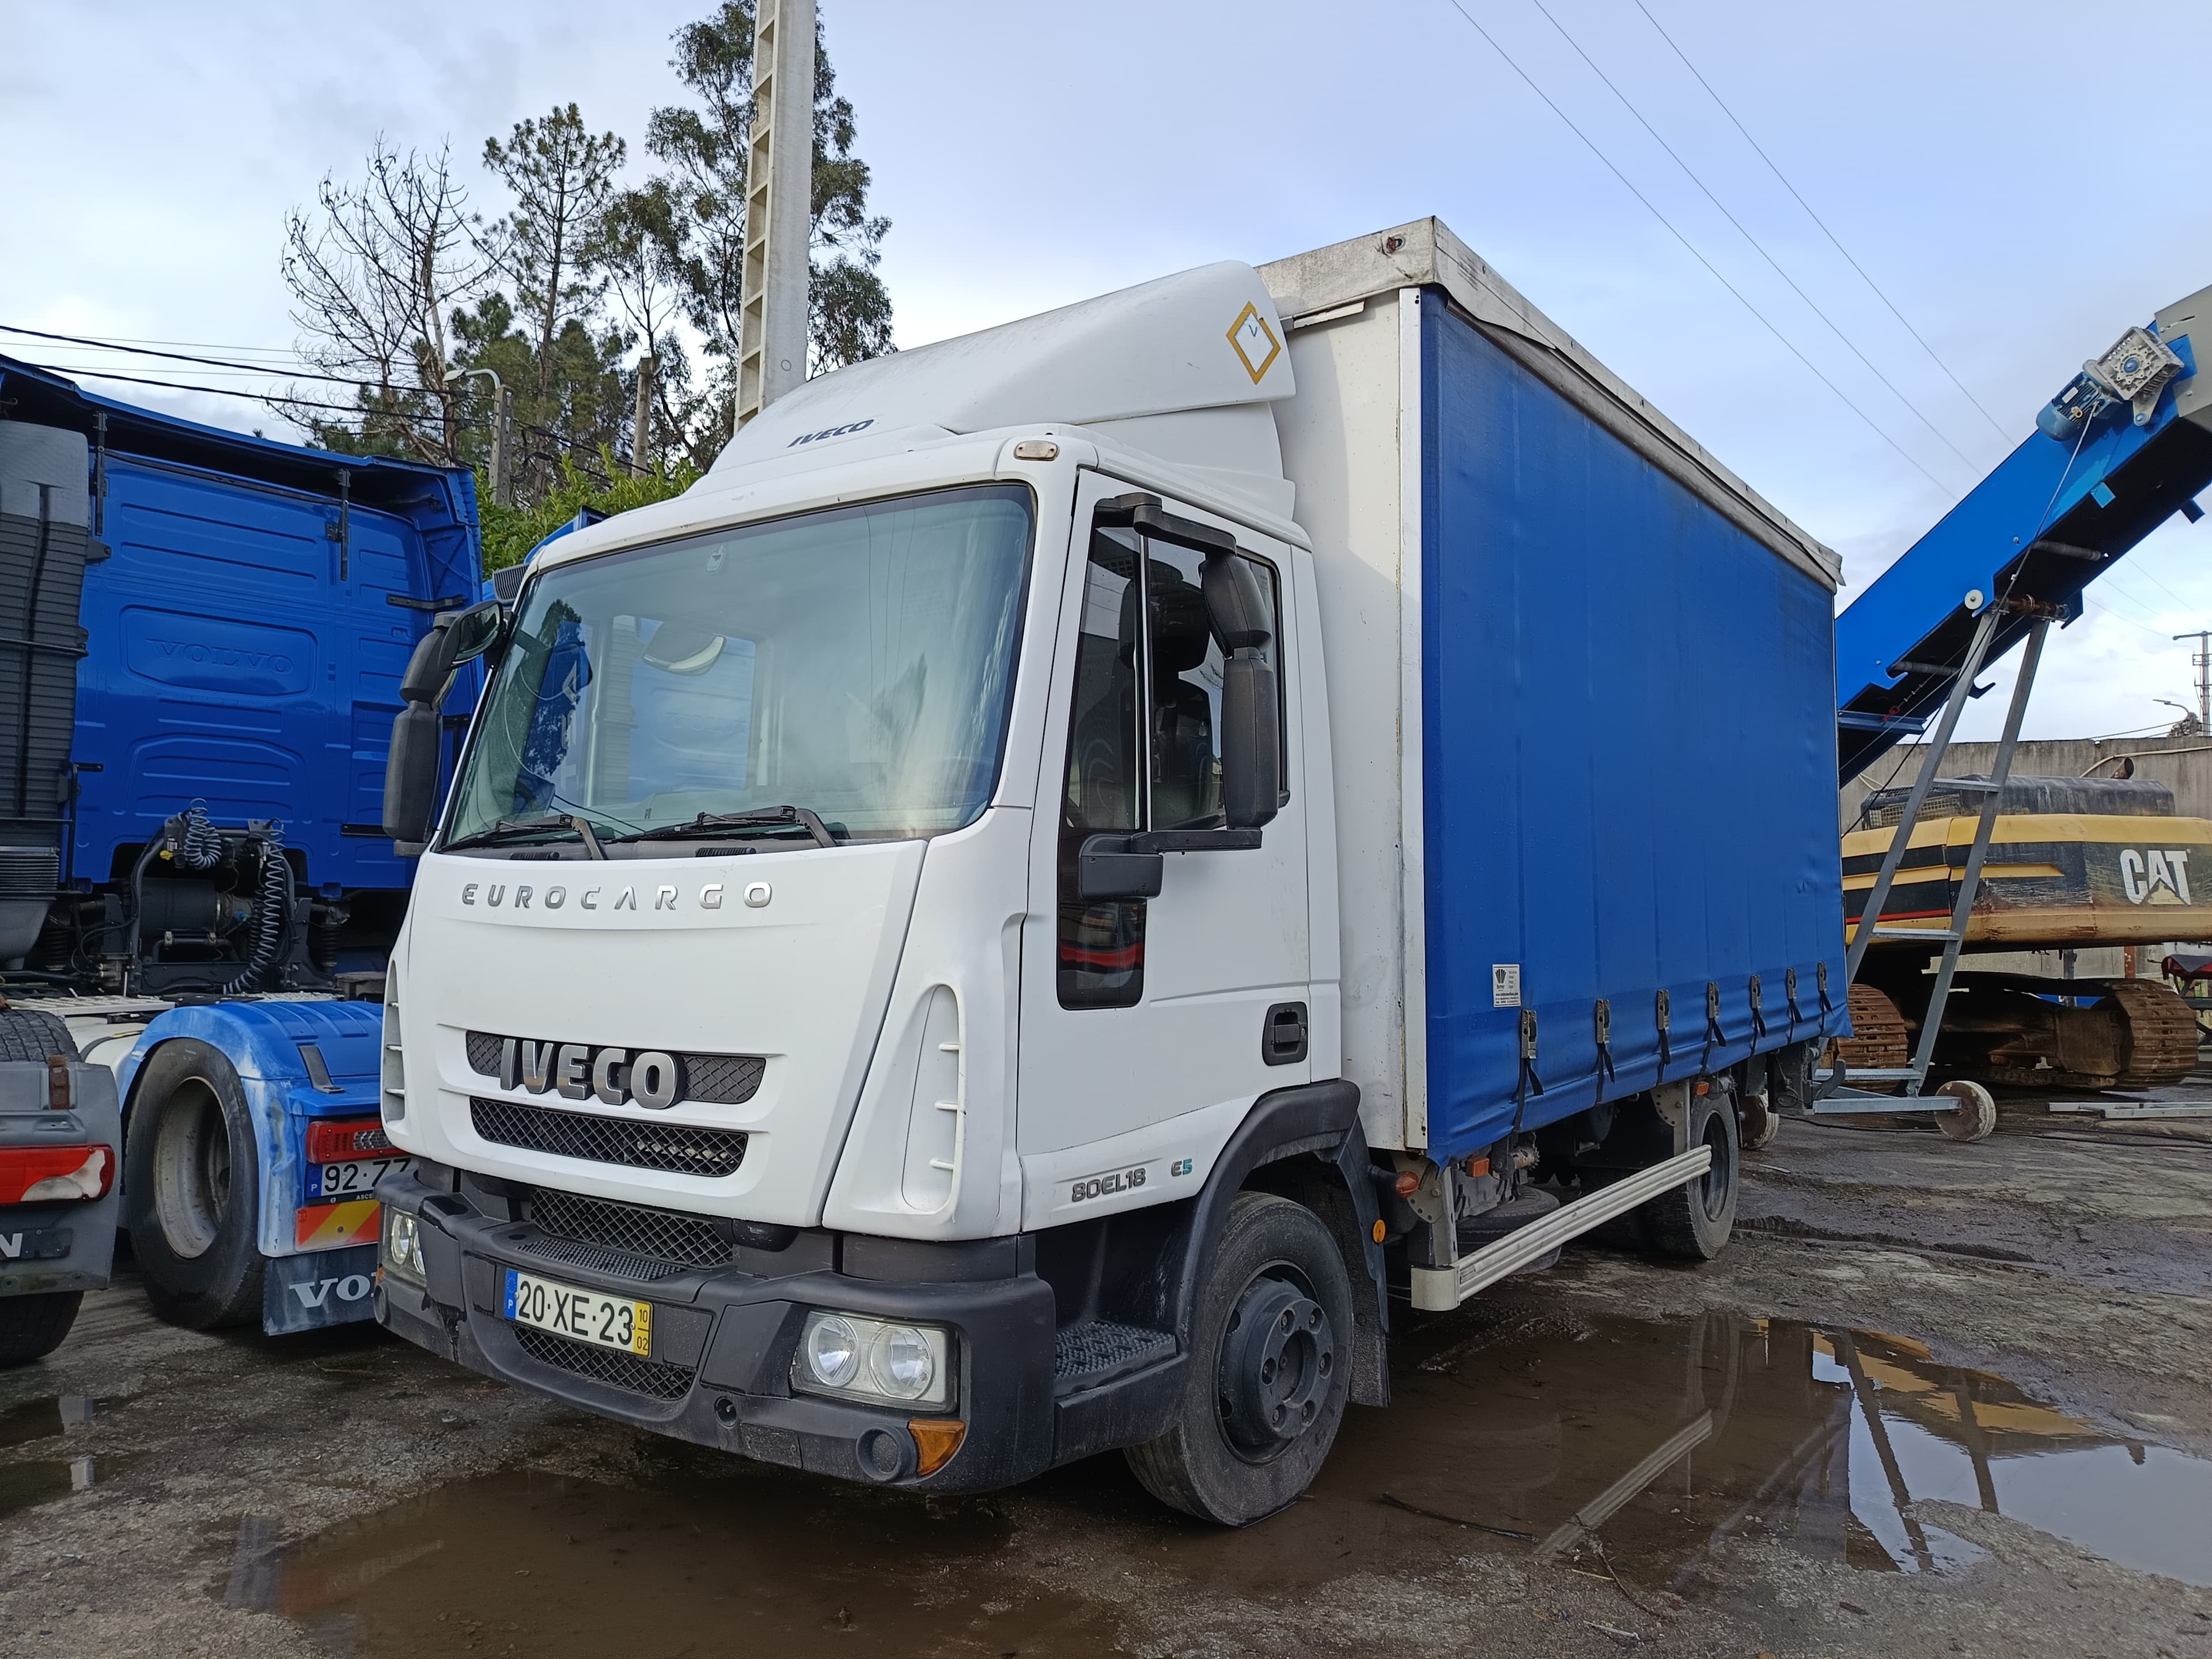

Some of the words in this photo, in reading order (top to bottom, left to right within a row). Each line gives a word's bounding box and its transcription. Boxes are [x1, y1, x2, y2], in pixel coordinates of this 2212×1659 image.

[787, 419, 874, 448] IVECO
[146, 638, 294, 675] VOLVO
[2120, 849, 2191, 905] CAT
[461, 881, 772, 910] EUROCARGO
[500, 1039, 677, 1110] IVECO
[311, 1184, 317, 1192] P
[1072, 1168, 1146, 1202] 80EL18
[1171, 1158, 1193, 1177] E5
[289, 1271, 376, 1308] VO
[507, 1299, 513, 1309] P
[639, 1309, 648, 1323] 10
[637, 1336, 648, 1351] 02
